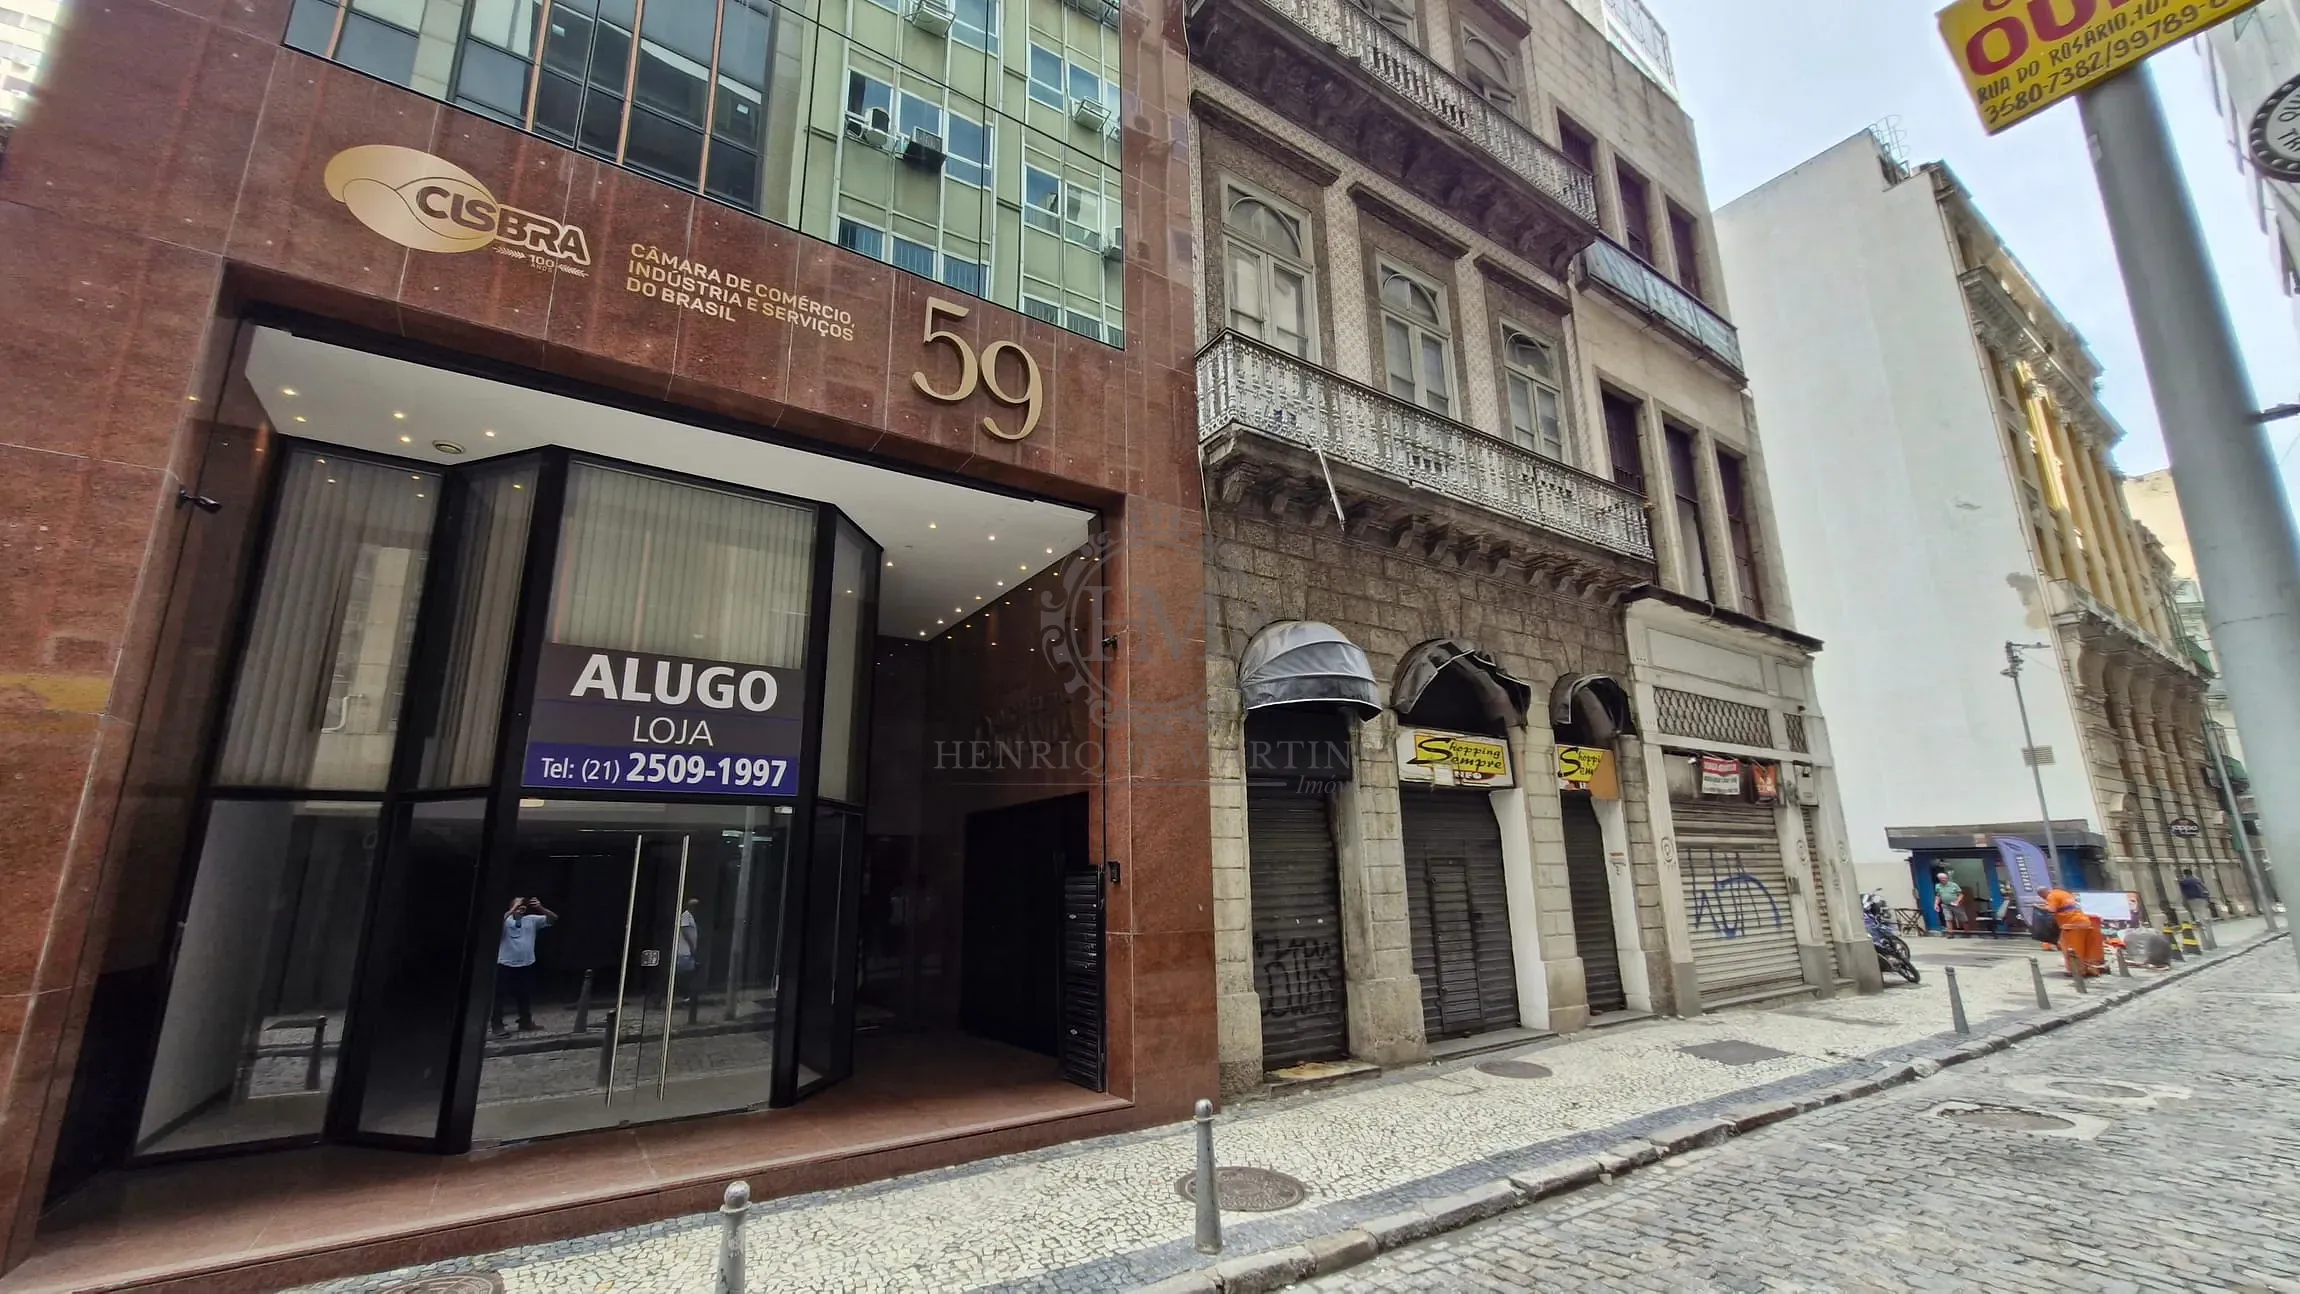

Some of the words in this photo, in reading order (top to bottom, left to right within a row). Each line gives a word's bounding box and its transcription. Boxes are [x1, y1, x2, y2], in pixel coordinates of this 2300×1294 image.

[1965, 0, 2131, 76] OU
[1985, 0, 2229, 125] 3580-7382/99789-
[1976, 81, 2012, 106] RUA
[2016, 60, 2041, 82] DO
[416, 185, 591, 267] CISBRA
[528, 253, 556, 269] 100
[631, 243, 722, 284] CÂMARA
[727, 273, 752, 293] DE
[755, 283, 856, 328] COMÉRCIO,
[626, 277, 657, 298] DO
[661, 287, 736, 323] BRASIL
[628, 259, 742, 308] INDÚSTRIA
[747, 296, 758, 312] E
[762, 302, 854, 341] SERVIÇOS
[911, 296, 1044, 441] 59
[570, 653, 778, 712] ALUGO
[632, 715, 714, 747] LOJA
[1406, 737, 1501, 764] Shopping
[541, 757, 575, 779] Tel:
[581, 757, 620, 783] (21)
[626, 752, 787, 787] 2509-1997
